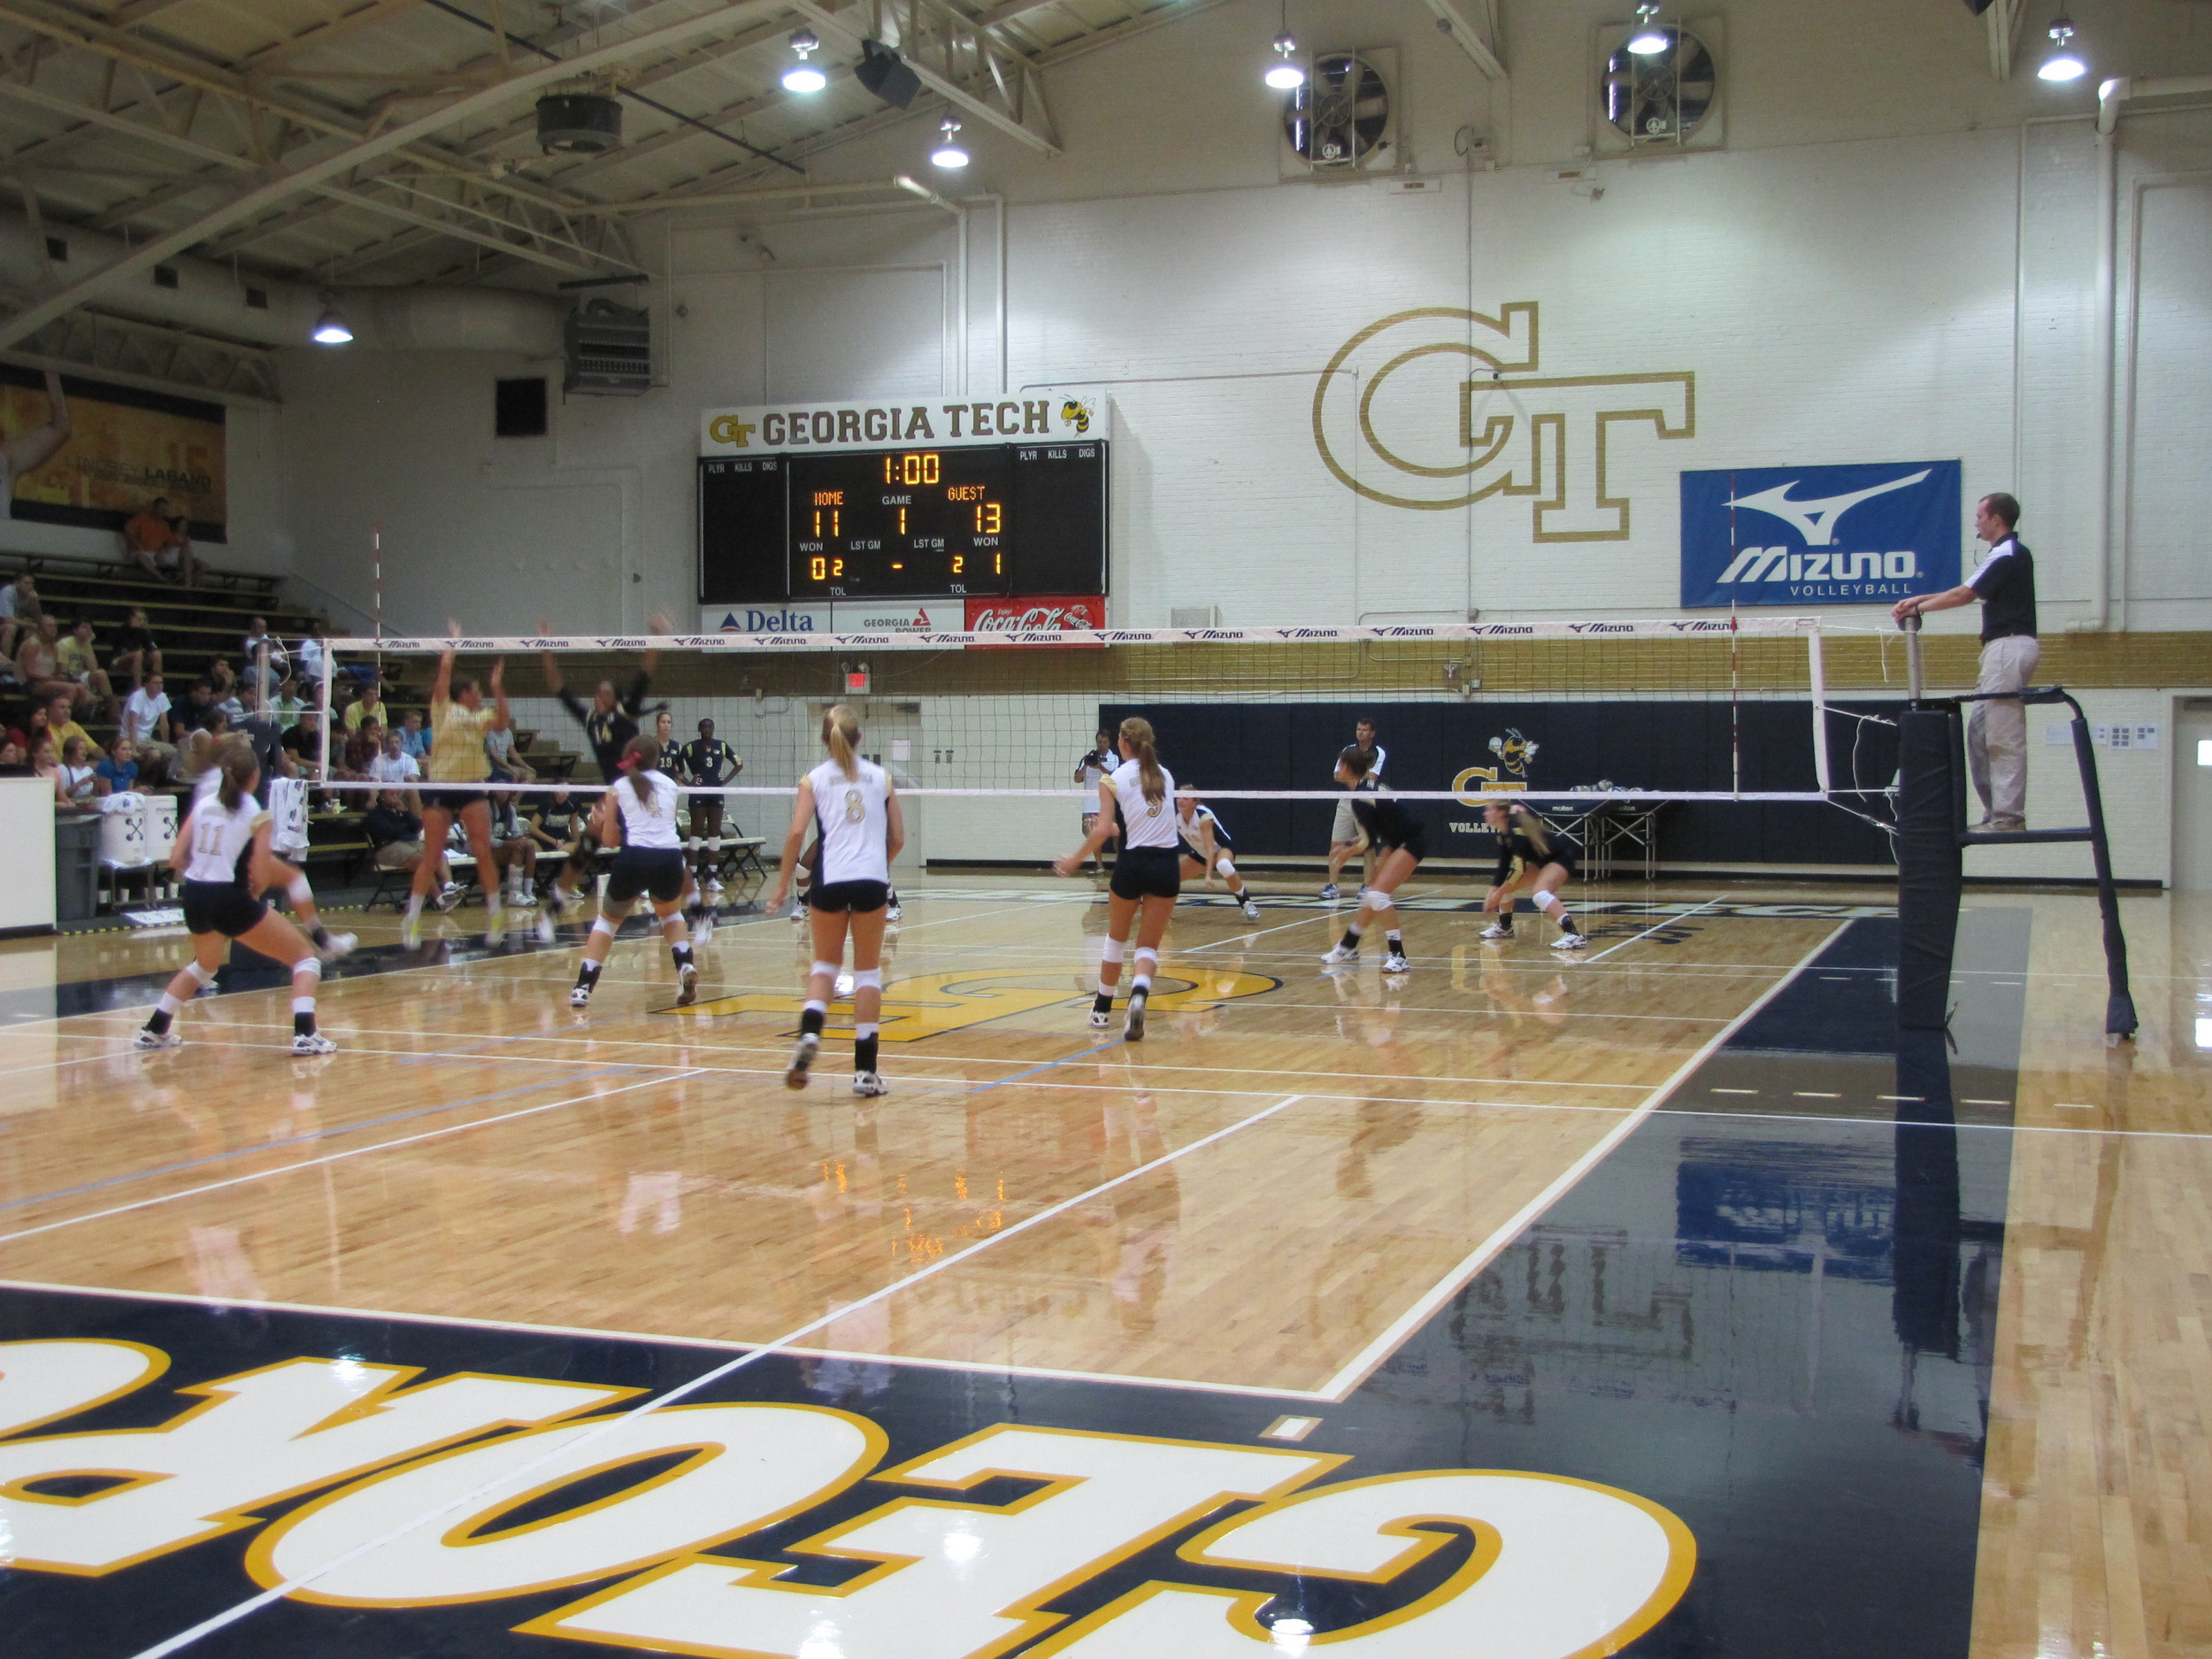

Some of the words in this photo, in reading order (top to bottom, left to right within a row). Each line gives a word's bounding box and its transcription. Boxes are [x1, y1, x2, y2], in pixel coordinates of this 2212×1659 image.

[763, 407, 934, 446] GEORGIA
[943, 400, 1049, 438] TECH
[1019, 451, 1038, 461] PLYR
[1048, 449, 1067, 459] KILLS
[1079, 449, 1095, 457] DIGS
[708, 464, 725, 473] PLYR
[734, 463, 752, 472] KILLS
[762, 462, 778, 471] DIGS
[886, 455, 940, 485] 1:00
[814, 491, 844, 506] HOME
[948, 486, 986, 501] GUEST
[882, 495, 912, 505] GAME
[816, 511, 839, 537] 11
[977, 503, 1001, 534] 13
[799, 542, 824, 552] WON
[850, 541, 865, 550] LST
[867, 541, 881, 549] GM
[913, 539, 929, 549] LST
[931, 538, 945, 548] GM
[973, 537, 999, 547] WON
[833, 559, 843, 576] 2
[953, 556, 964, 573] 2
[830, 587, 847, 595] TOL
[950, 584, 967, 593] TOL
[1790, 583, 1912, 596] VOLLEYBALL
[746, 610, 814, 633] Delta
[864, 618, 910, 627] GEORGIA
[845, 789, 865, 825] 8
[197, 823, 226, 856] 11
[0, 1338, 1697, 1659] GEOR
